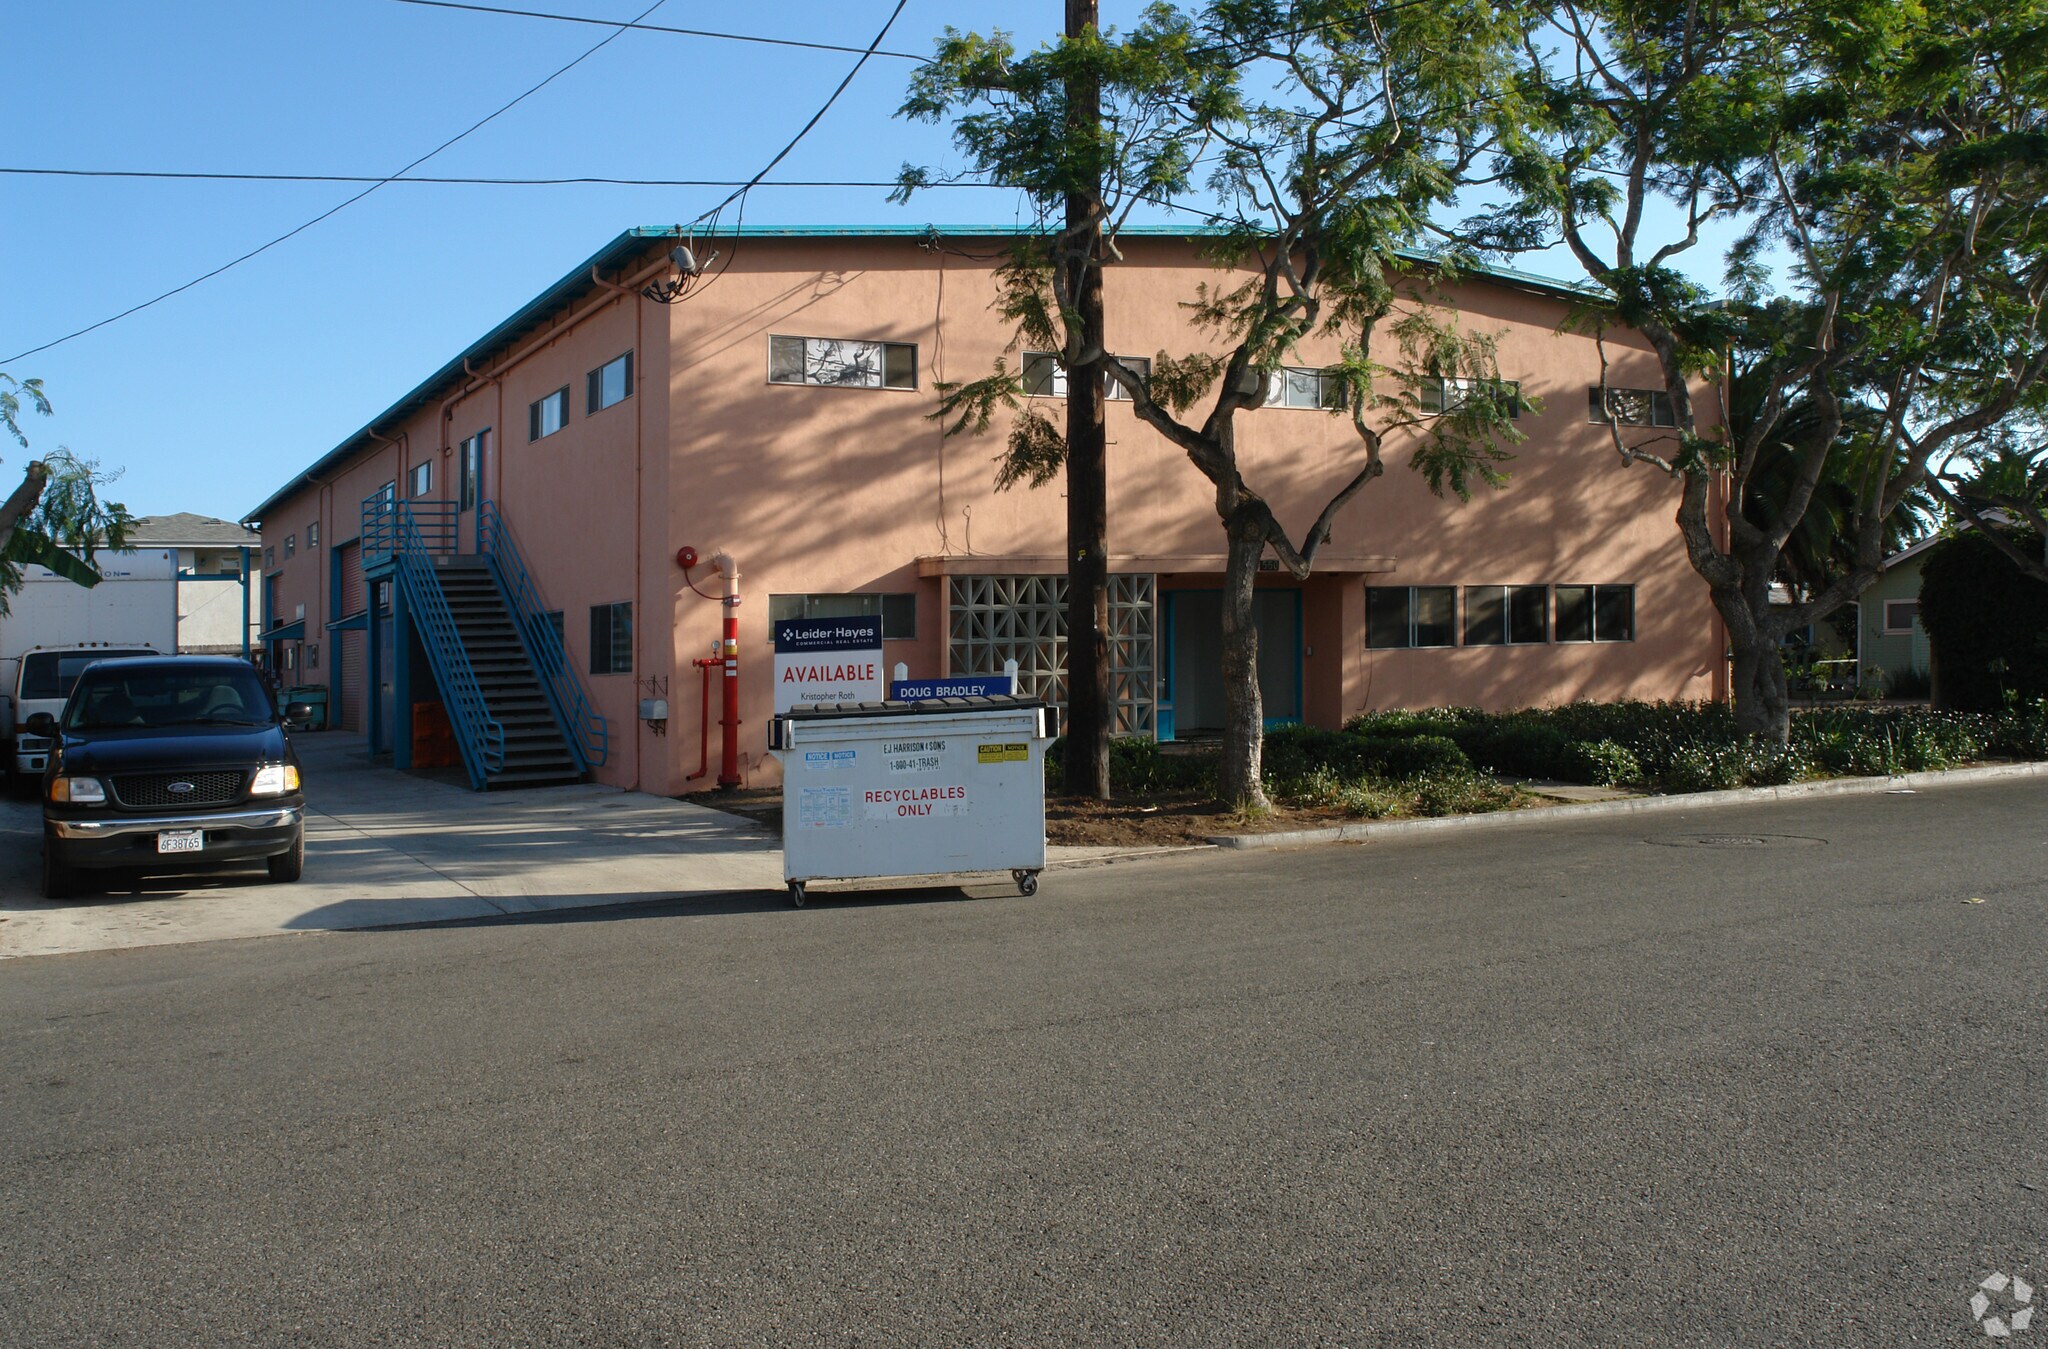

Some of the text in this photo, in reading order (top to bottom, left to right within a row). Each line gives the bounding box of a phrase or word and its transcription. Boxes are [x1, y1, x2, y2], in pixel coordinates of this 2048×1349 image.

[783, 664, 874, 683] AVAILABLE
[800, 691, 855, 702] Kristopher Roth
[900, 685, 986, 698] DOUG BRADLEY
[893, 743, 925, 753] HARRISON
[929, 740, 946, 751] SONS
[980, 745, 1002, 753] CAUTION
[807, 752, 828, 760] NOTICE
[834, 751, 854, 760] NOTICE
[865, 786, 965, 803] RECYCLABLES
[897, 803, 933, 817] ONLY
[161, 837, 200, 851] 6F38765
